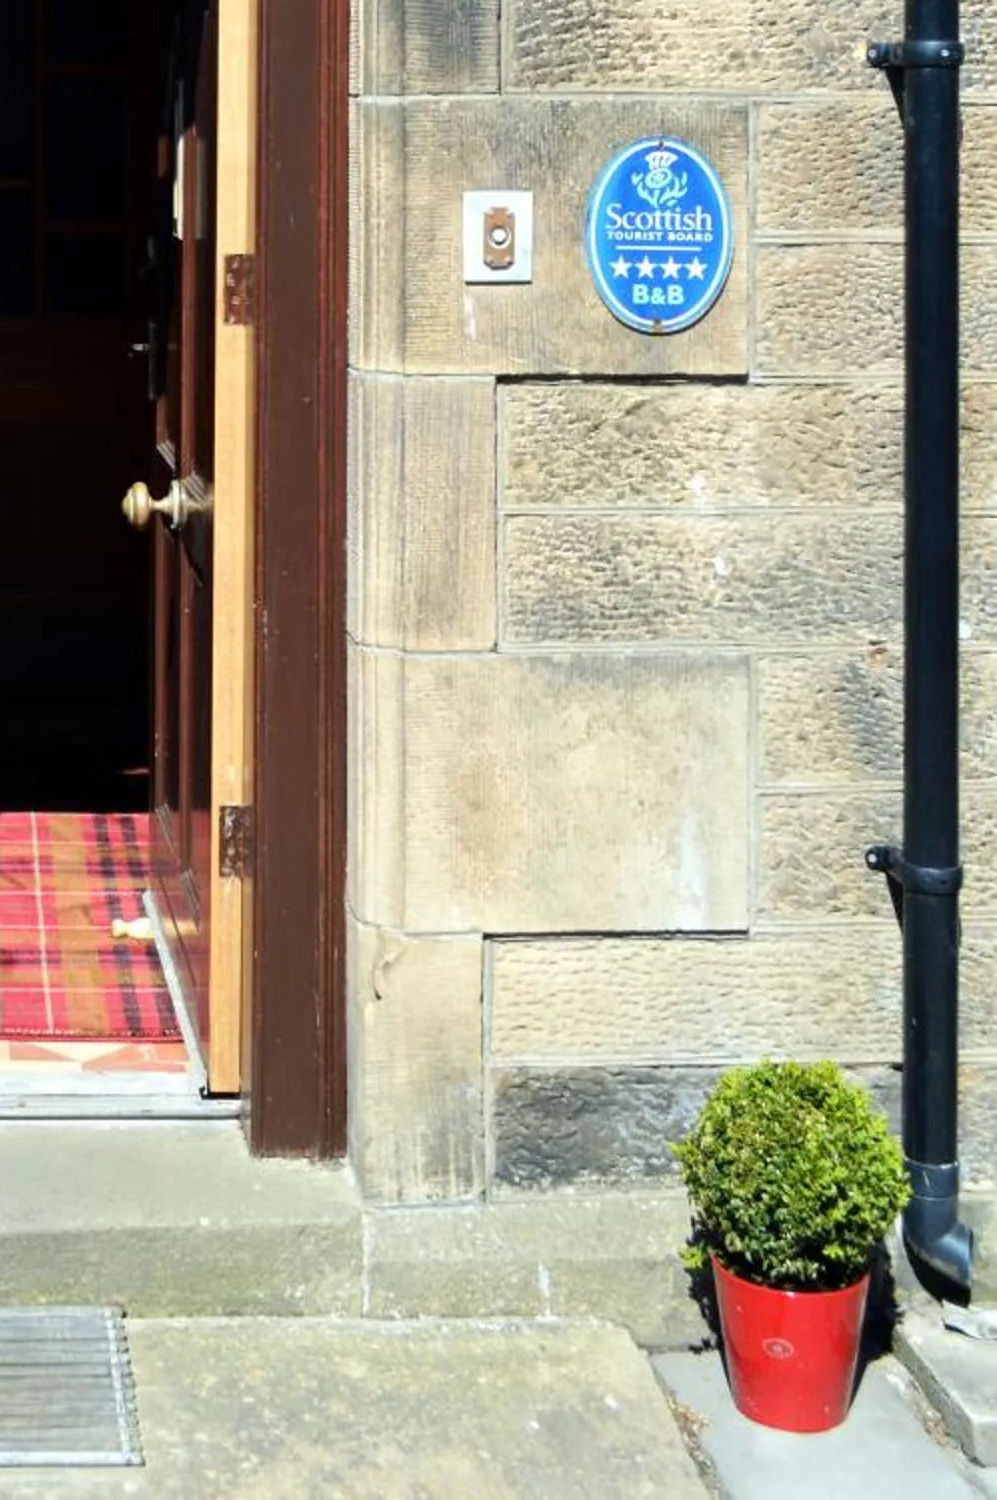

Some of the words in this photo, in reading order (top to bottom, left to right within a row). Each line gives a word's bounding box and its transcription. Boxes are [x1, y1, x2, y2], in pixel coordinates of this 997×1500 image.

[605, 203, 713, 231] Scottish
[606, 231, 663, 241] TOURIST
[667, 232, 713, 242] BOARD
[632, 284, 684, 305] B&B
